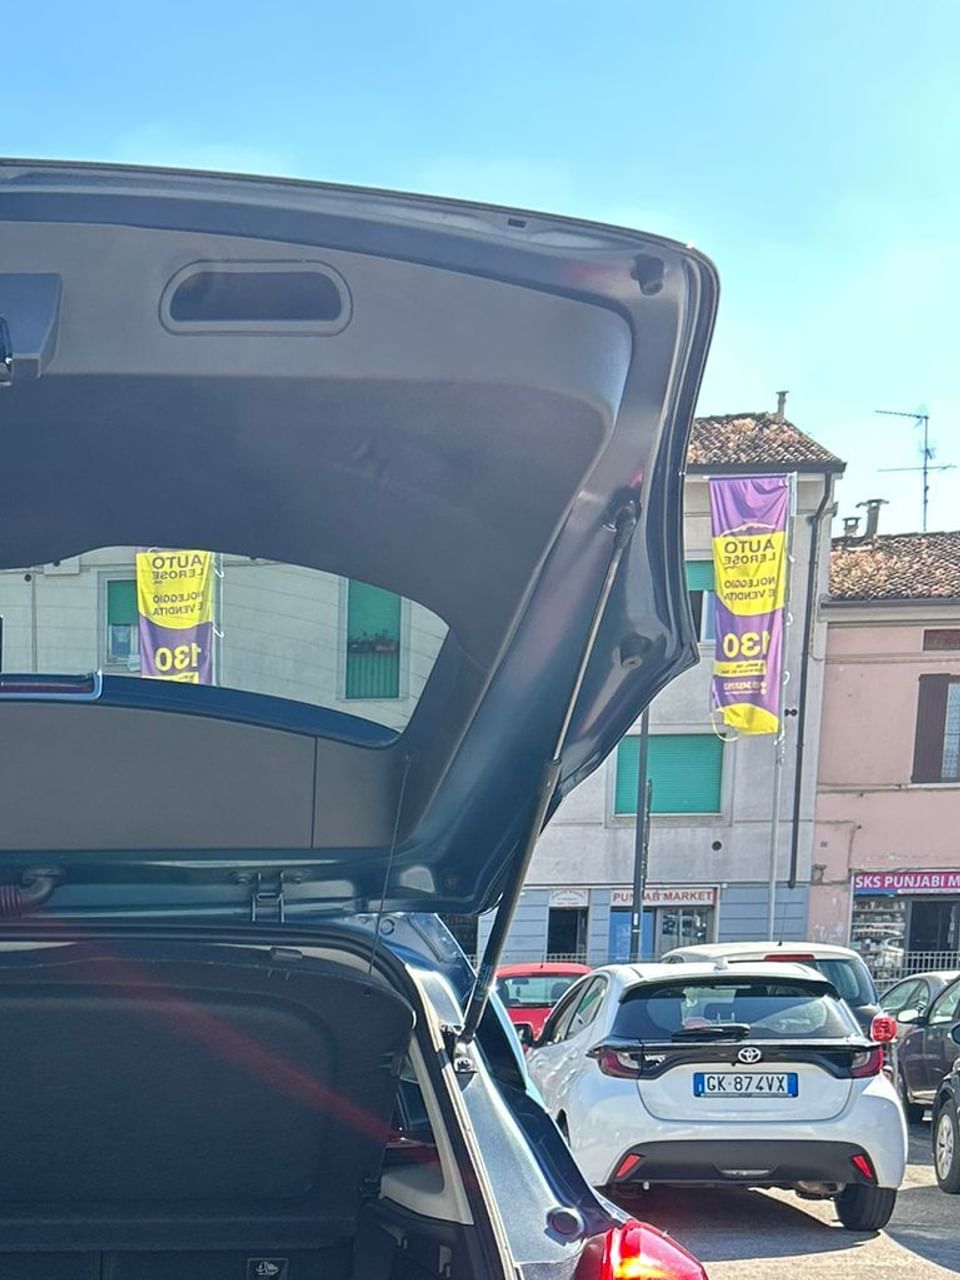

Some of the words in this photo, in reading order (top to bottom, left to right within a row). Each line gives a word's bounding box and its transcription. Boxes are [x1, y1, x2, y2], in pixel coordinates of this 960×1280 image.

[855, 875, 882, 888] SKS
[884, 875, 945, 888] PUNJABI
[663, 891, 713, 901] MARKET
[707, 1076, 726, 1092] GK
[733, 1076, 786, 1092] 874VX
